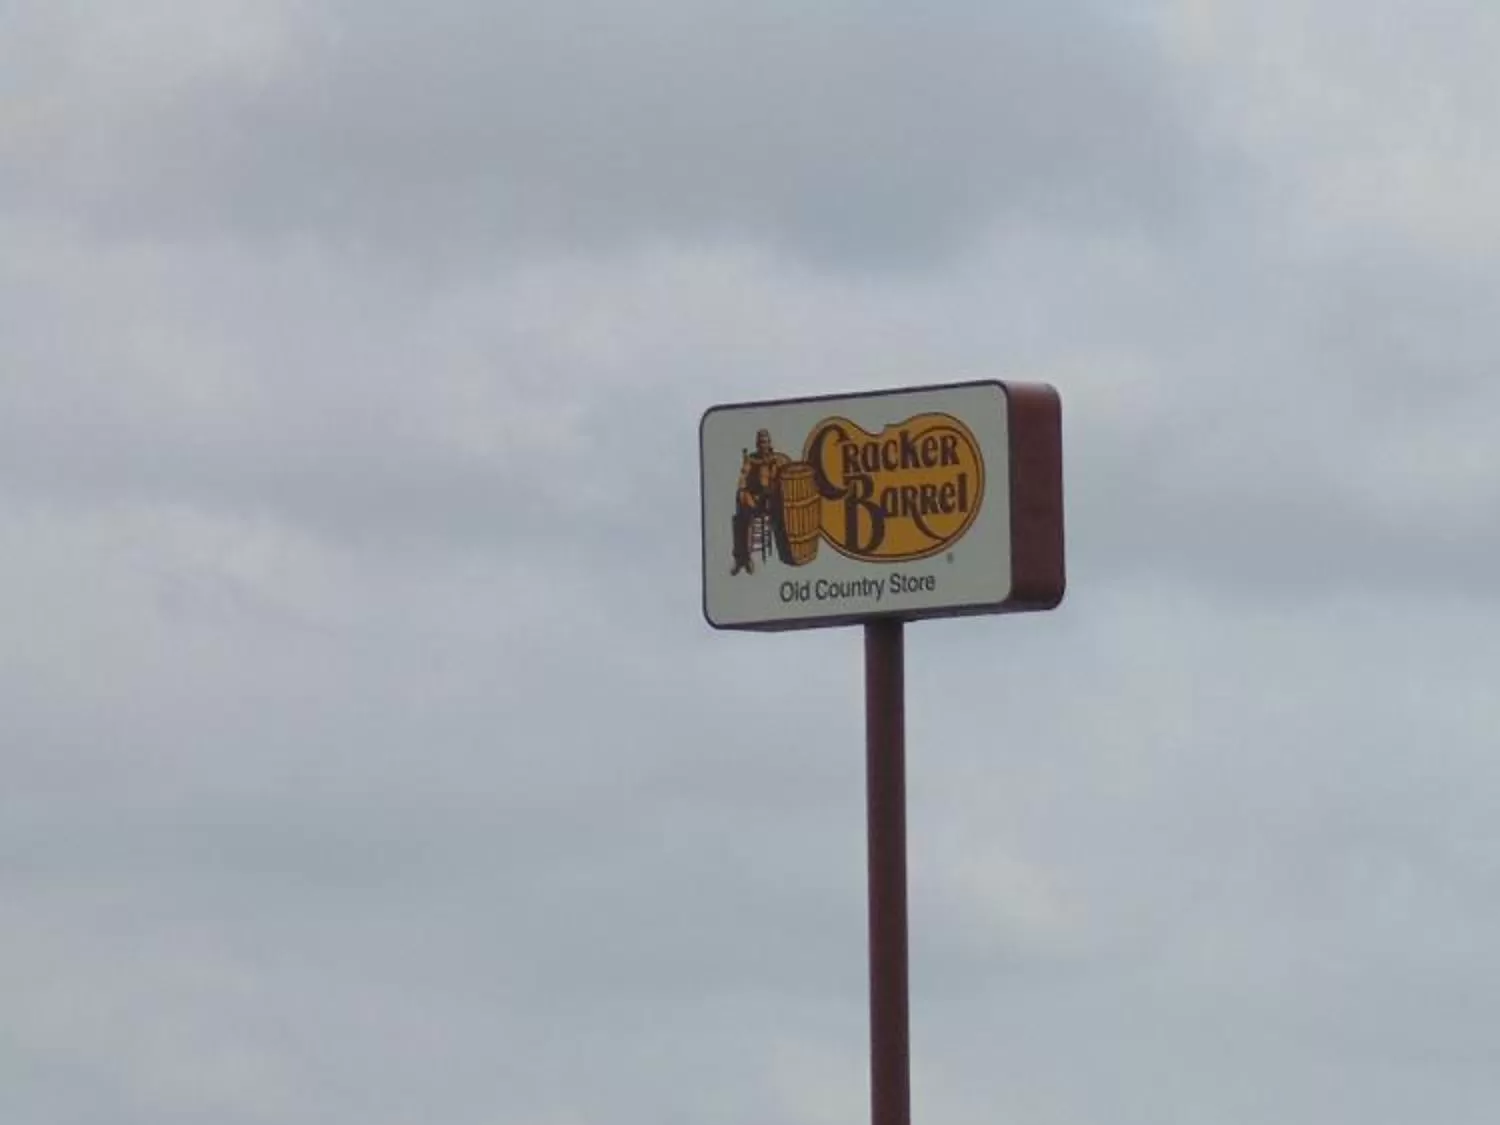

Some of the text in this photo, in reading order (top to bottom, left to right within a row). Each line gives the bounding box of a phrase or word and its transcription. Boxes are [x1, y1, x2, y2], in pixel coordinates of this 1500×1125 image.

[808, 421, 960, 500] Cracker
[843, 472, 968, 554] Barrel
[779, 572, 935, 602] Old Country Store
